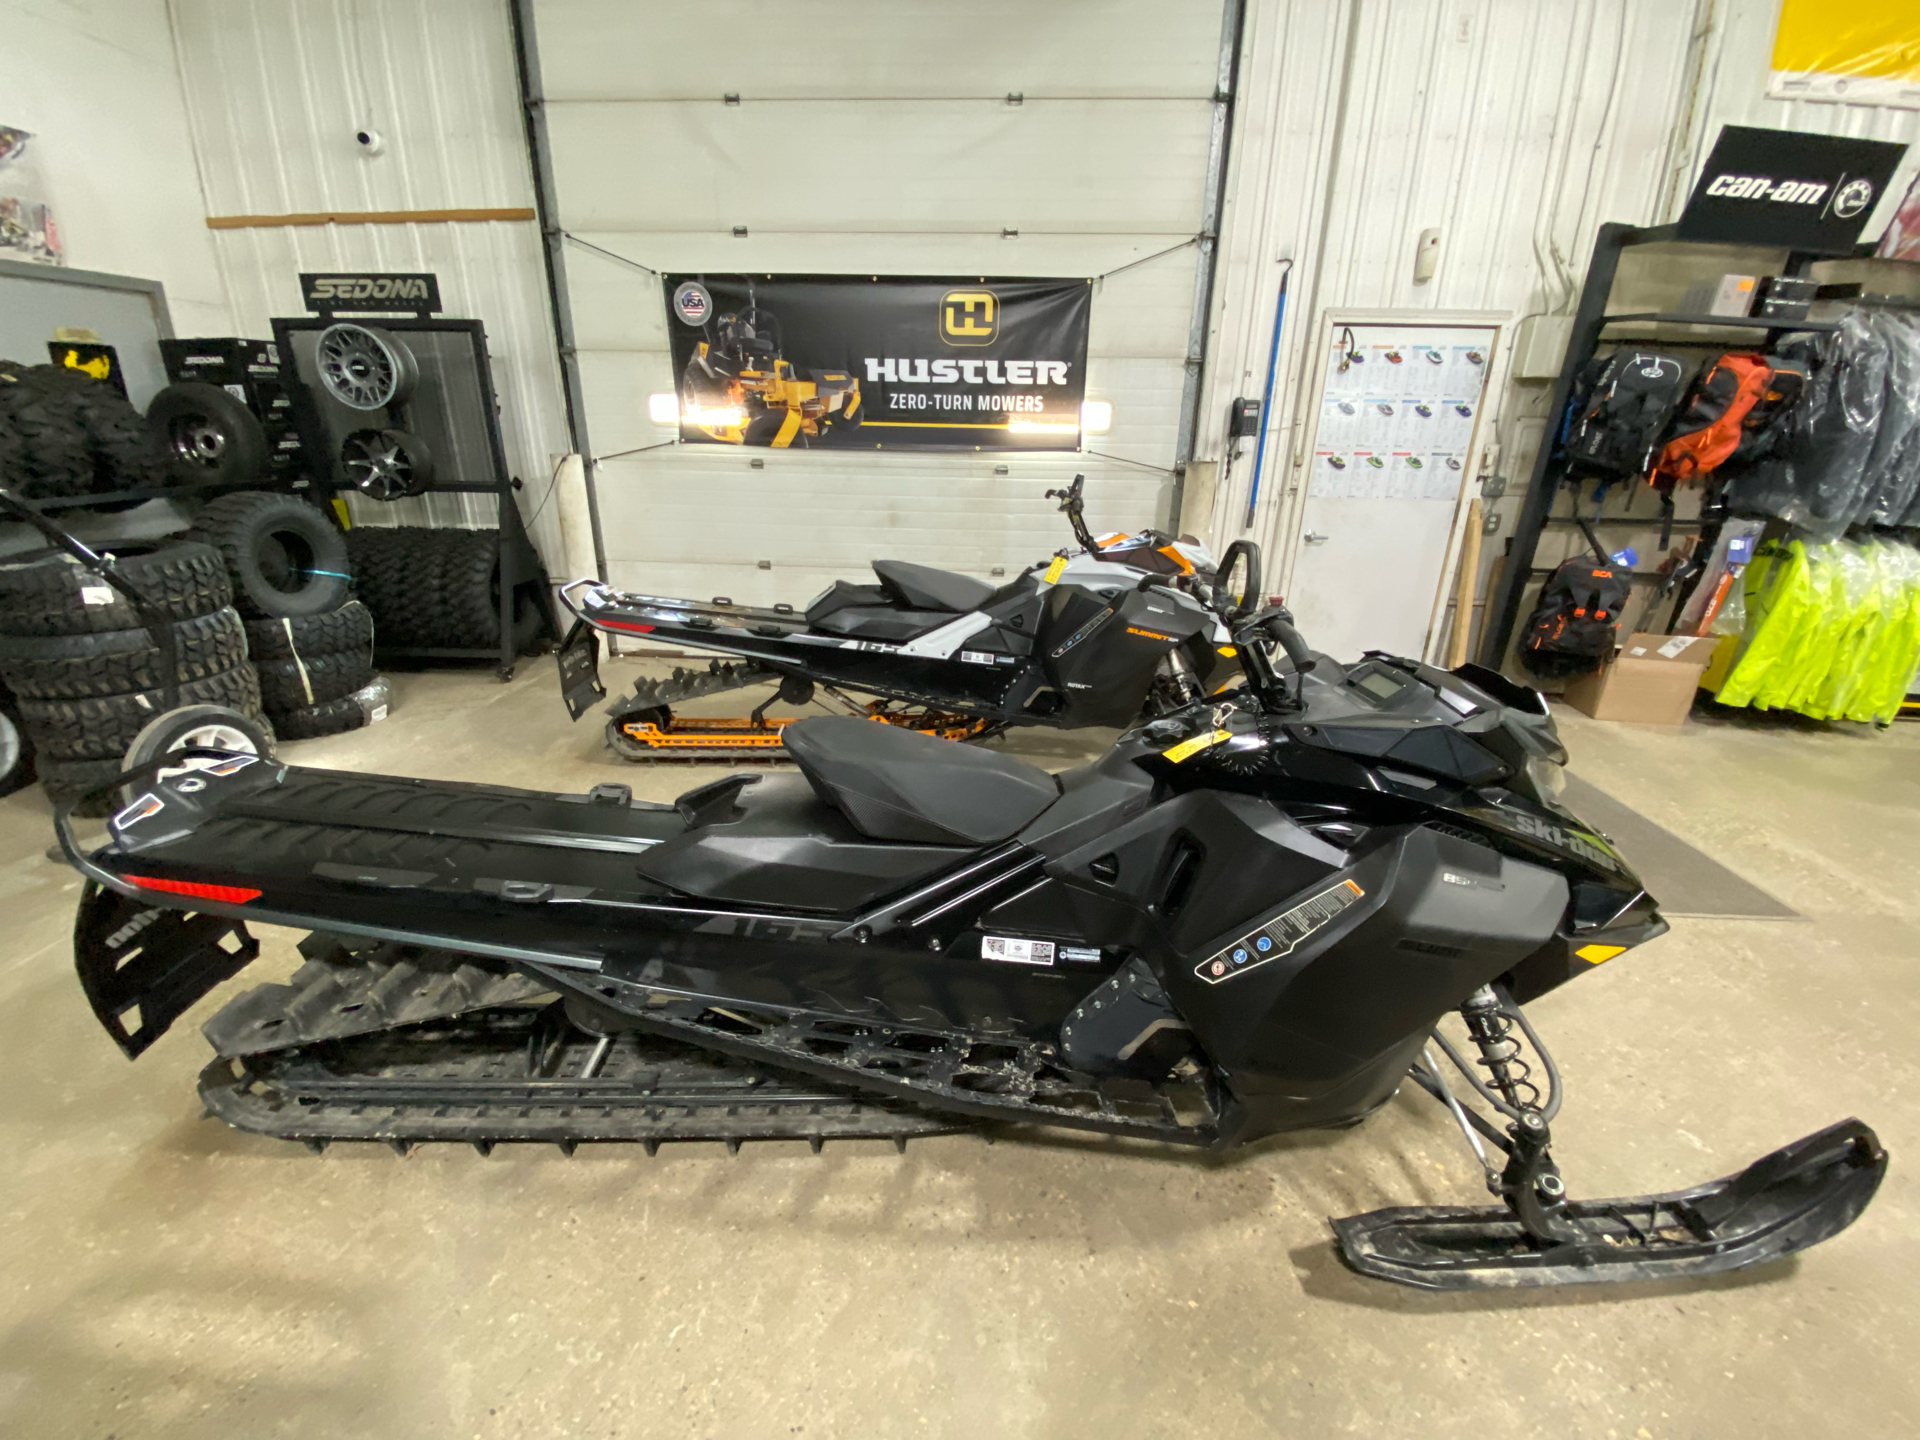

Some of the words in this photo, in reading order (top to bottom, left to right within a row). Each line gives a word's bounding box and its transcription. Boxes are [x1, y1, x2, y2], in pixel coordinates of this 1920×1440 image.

[1706, 175, 1828, 204] can-am
[309, 278, 429, 299] SEDONA
[681, 297, 705, 307] USA
[864, 357, 1068, 385] HUSTLER
[889, 393, 973, 411] ZERO-TURN
[978, 394, 1044, 412] MOWERS
[1126, 626, 1168, 641] SUMMIT
